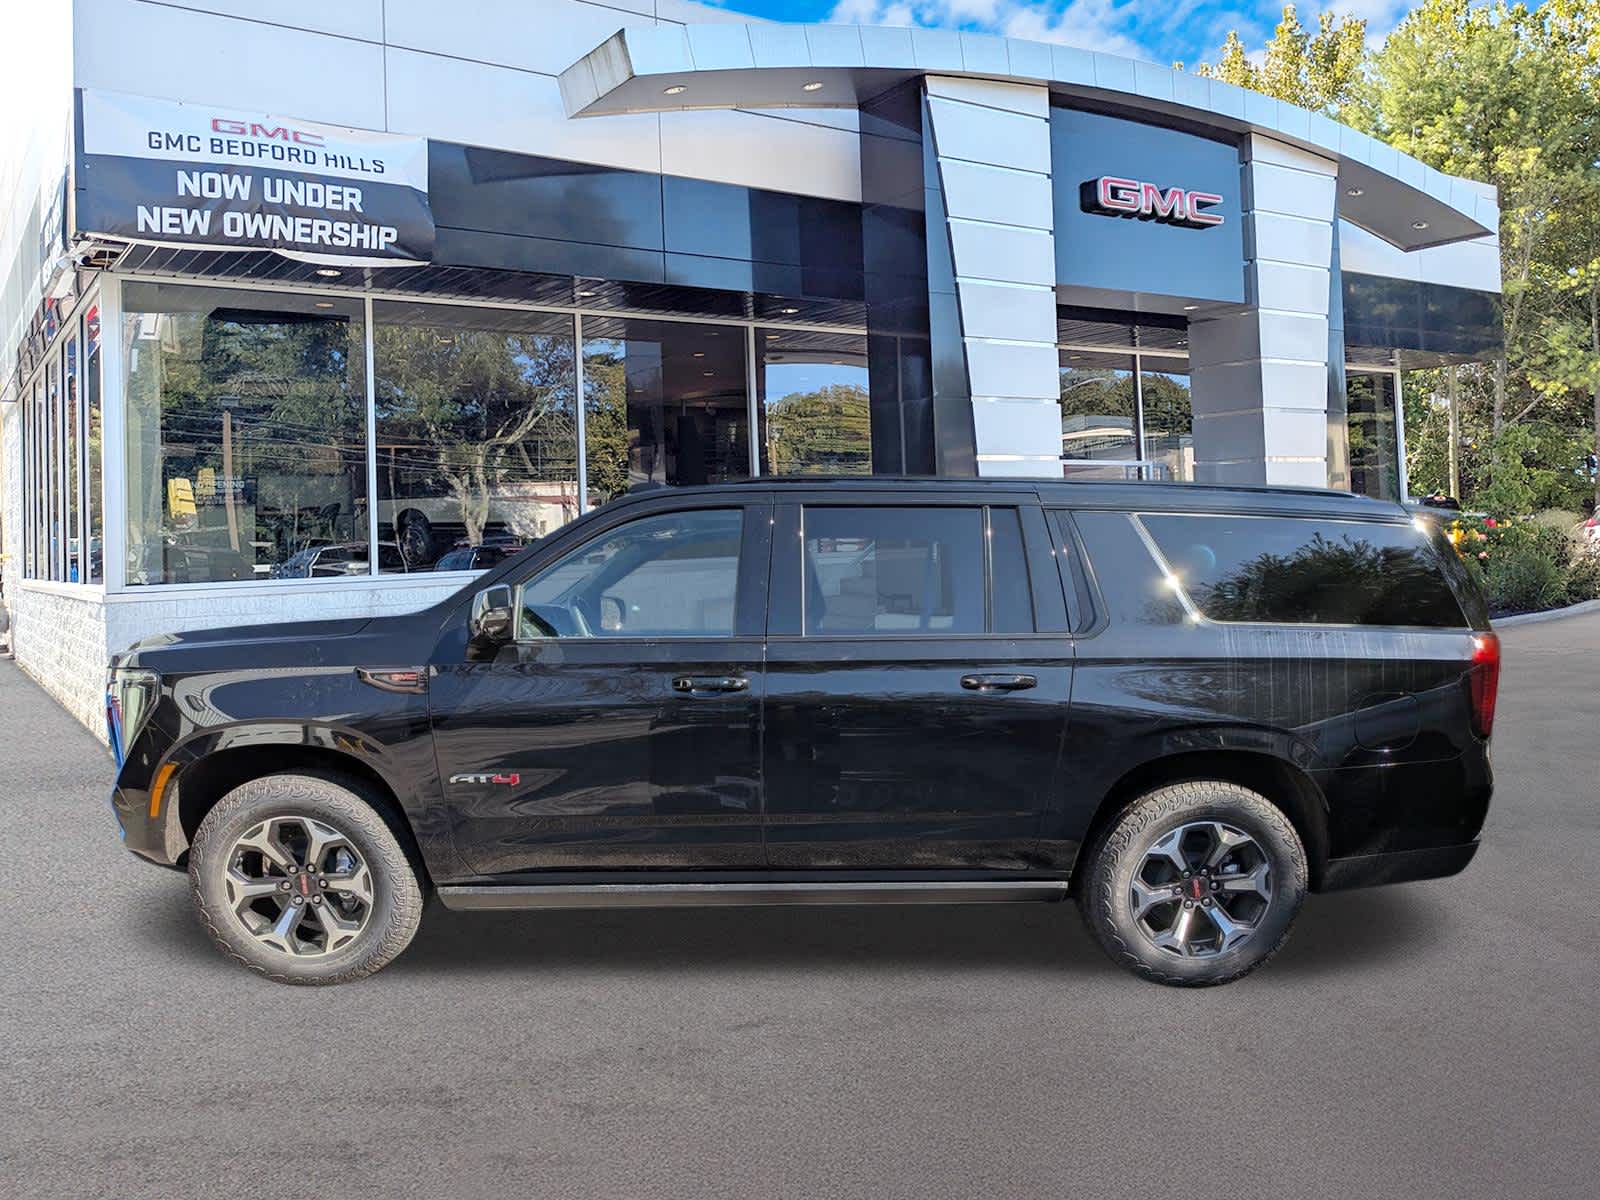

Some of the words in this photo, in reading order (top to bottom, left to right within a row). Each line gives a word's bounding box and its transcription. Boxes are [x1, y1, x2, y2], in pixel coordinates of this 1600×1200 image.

[148, 131, 201, 153] GMC
[210, 137, 317, 165] BEDFORD
[325, 153, 385, 174] HILLS
[211, 117, 326, 148] GMC
[177, 170, 253, 201] NOW
[263, 176, 364, 213] UNDER
[1097, 175, 1225, 225] GMC
[137, 205, 212, 236] NEW
[223, 211, 398, 250] OWNERSHIP
